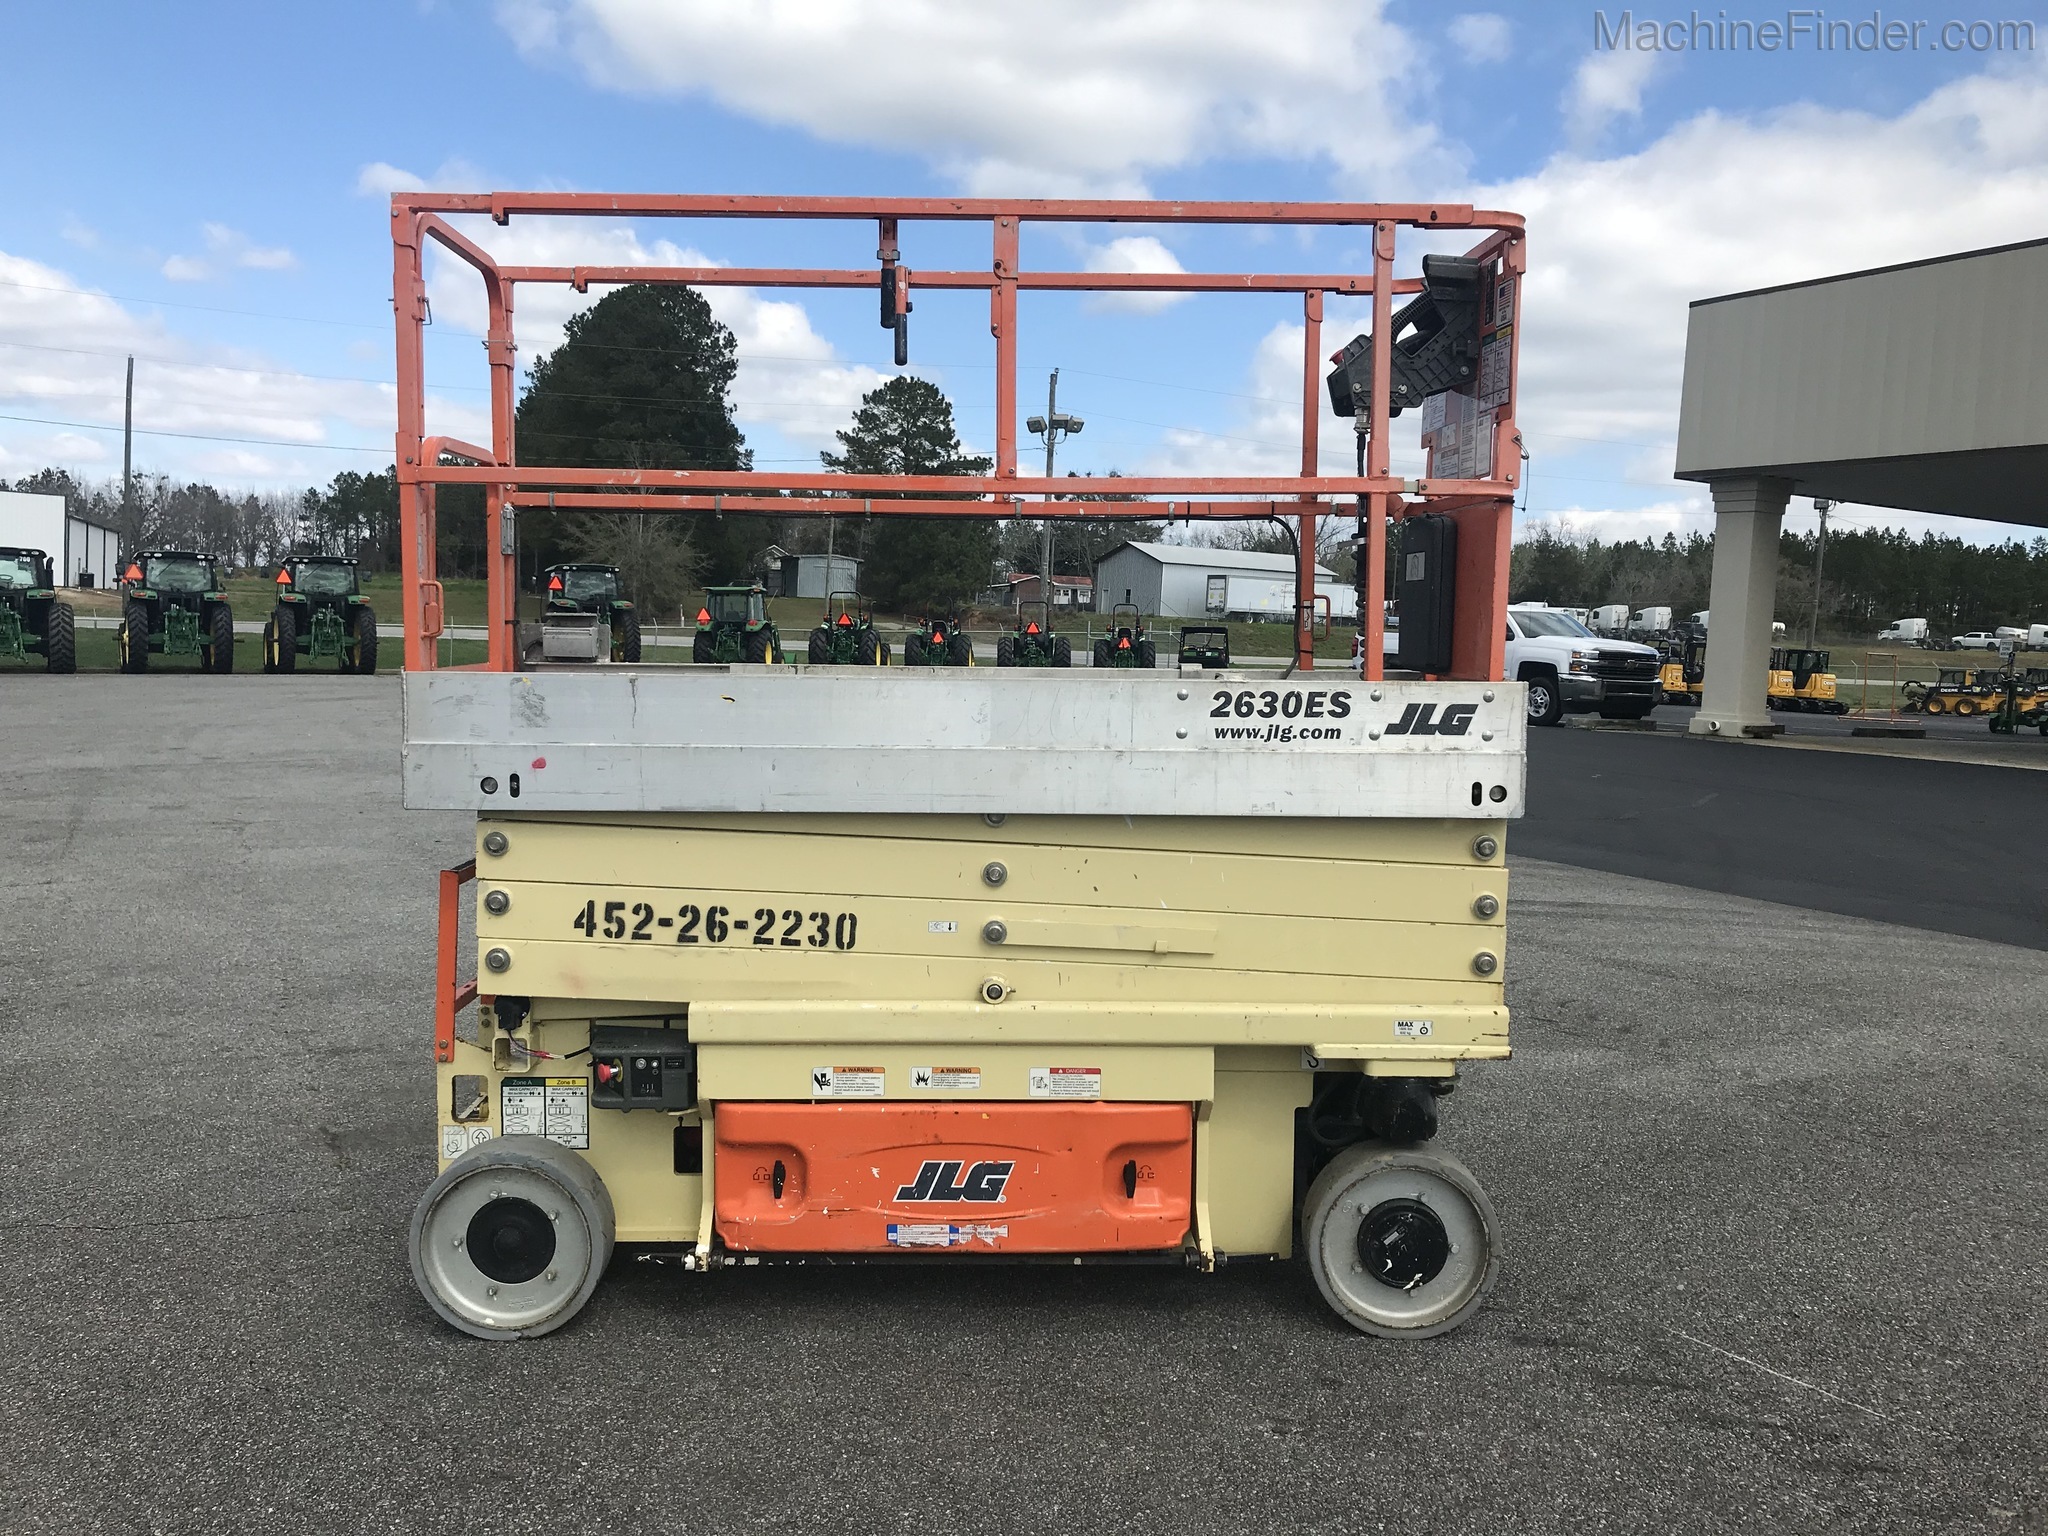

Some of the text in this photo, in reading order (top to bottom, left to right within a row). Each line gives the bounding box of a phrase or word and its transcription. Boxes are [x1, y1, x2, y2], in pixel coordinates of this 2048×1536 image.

[1209, 690, 1352, 718] 2630ES
[1383, 703, 1479, 736] JLG
[1214, 724, 1342, 743] www.jlg.com
[574, 899, 858, 950] 452-26-2230
[892, 1160, 1016, 1203] JLG
